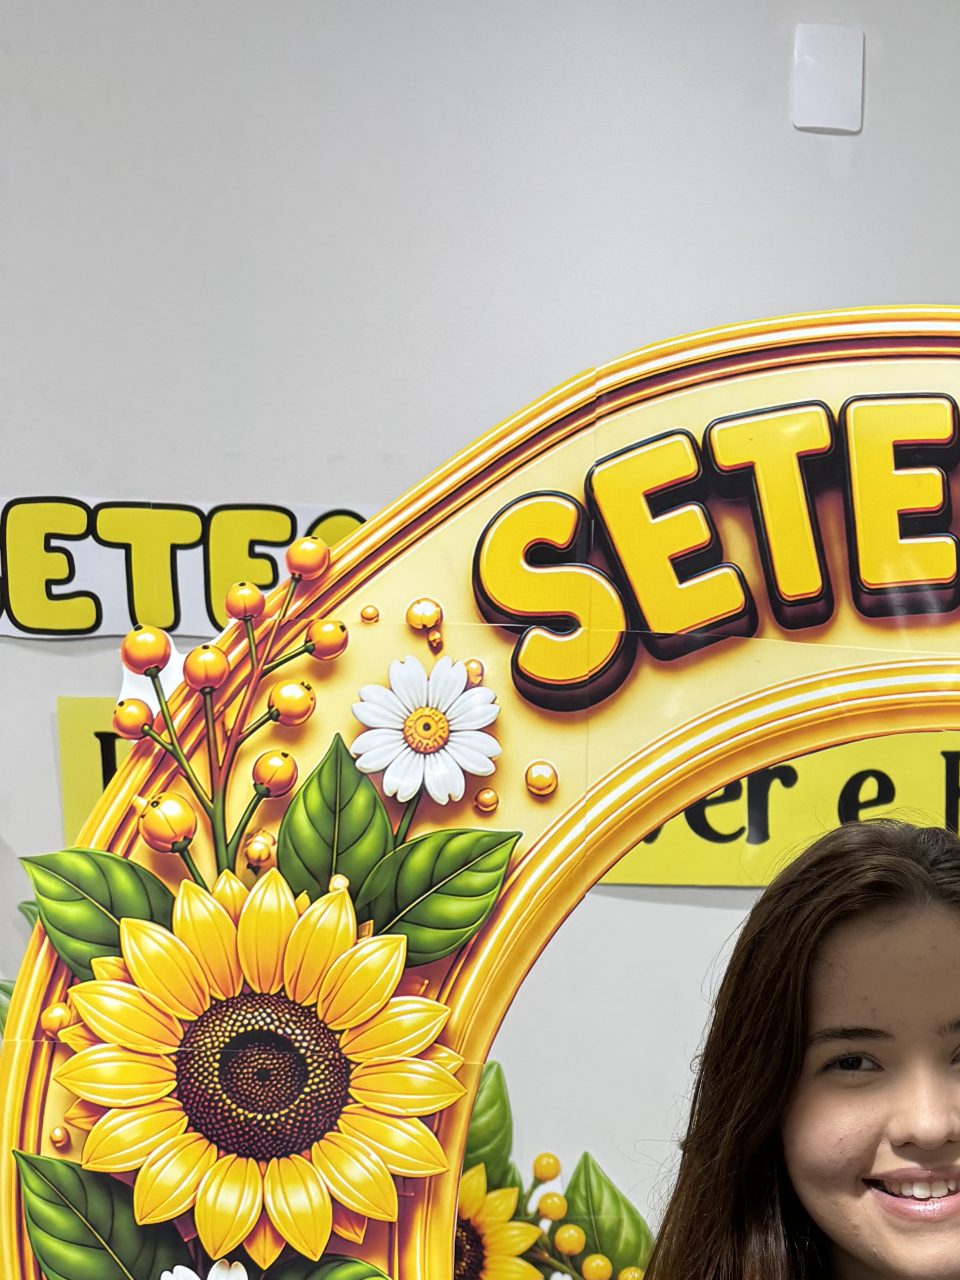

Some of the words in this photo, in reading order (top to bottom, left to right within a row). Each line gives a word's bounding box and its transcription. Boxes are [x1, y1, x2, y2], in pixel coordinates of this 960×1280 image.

[0, 496, 368, 635] ETE
[642, 764, 799, 845] er
[838, 768, 897, 829] e
